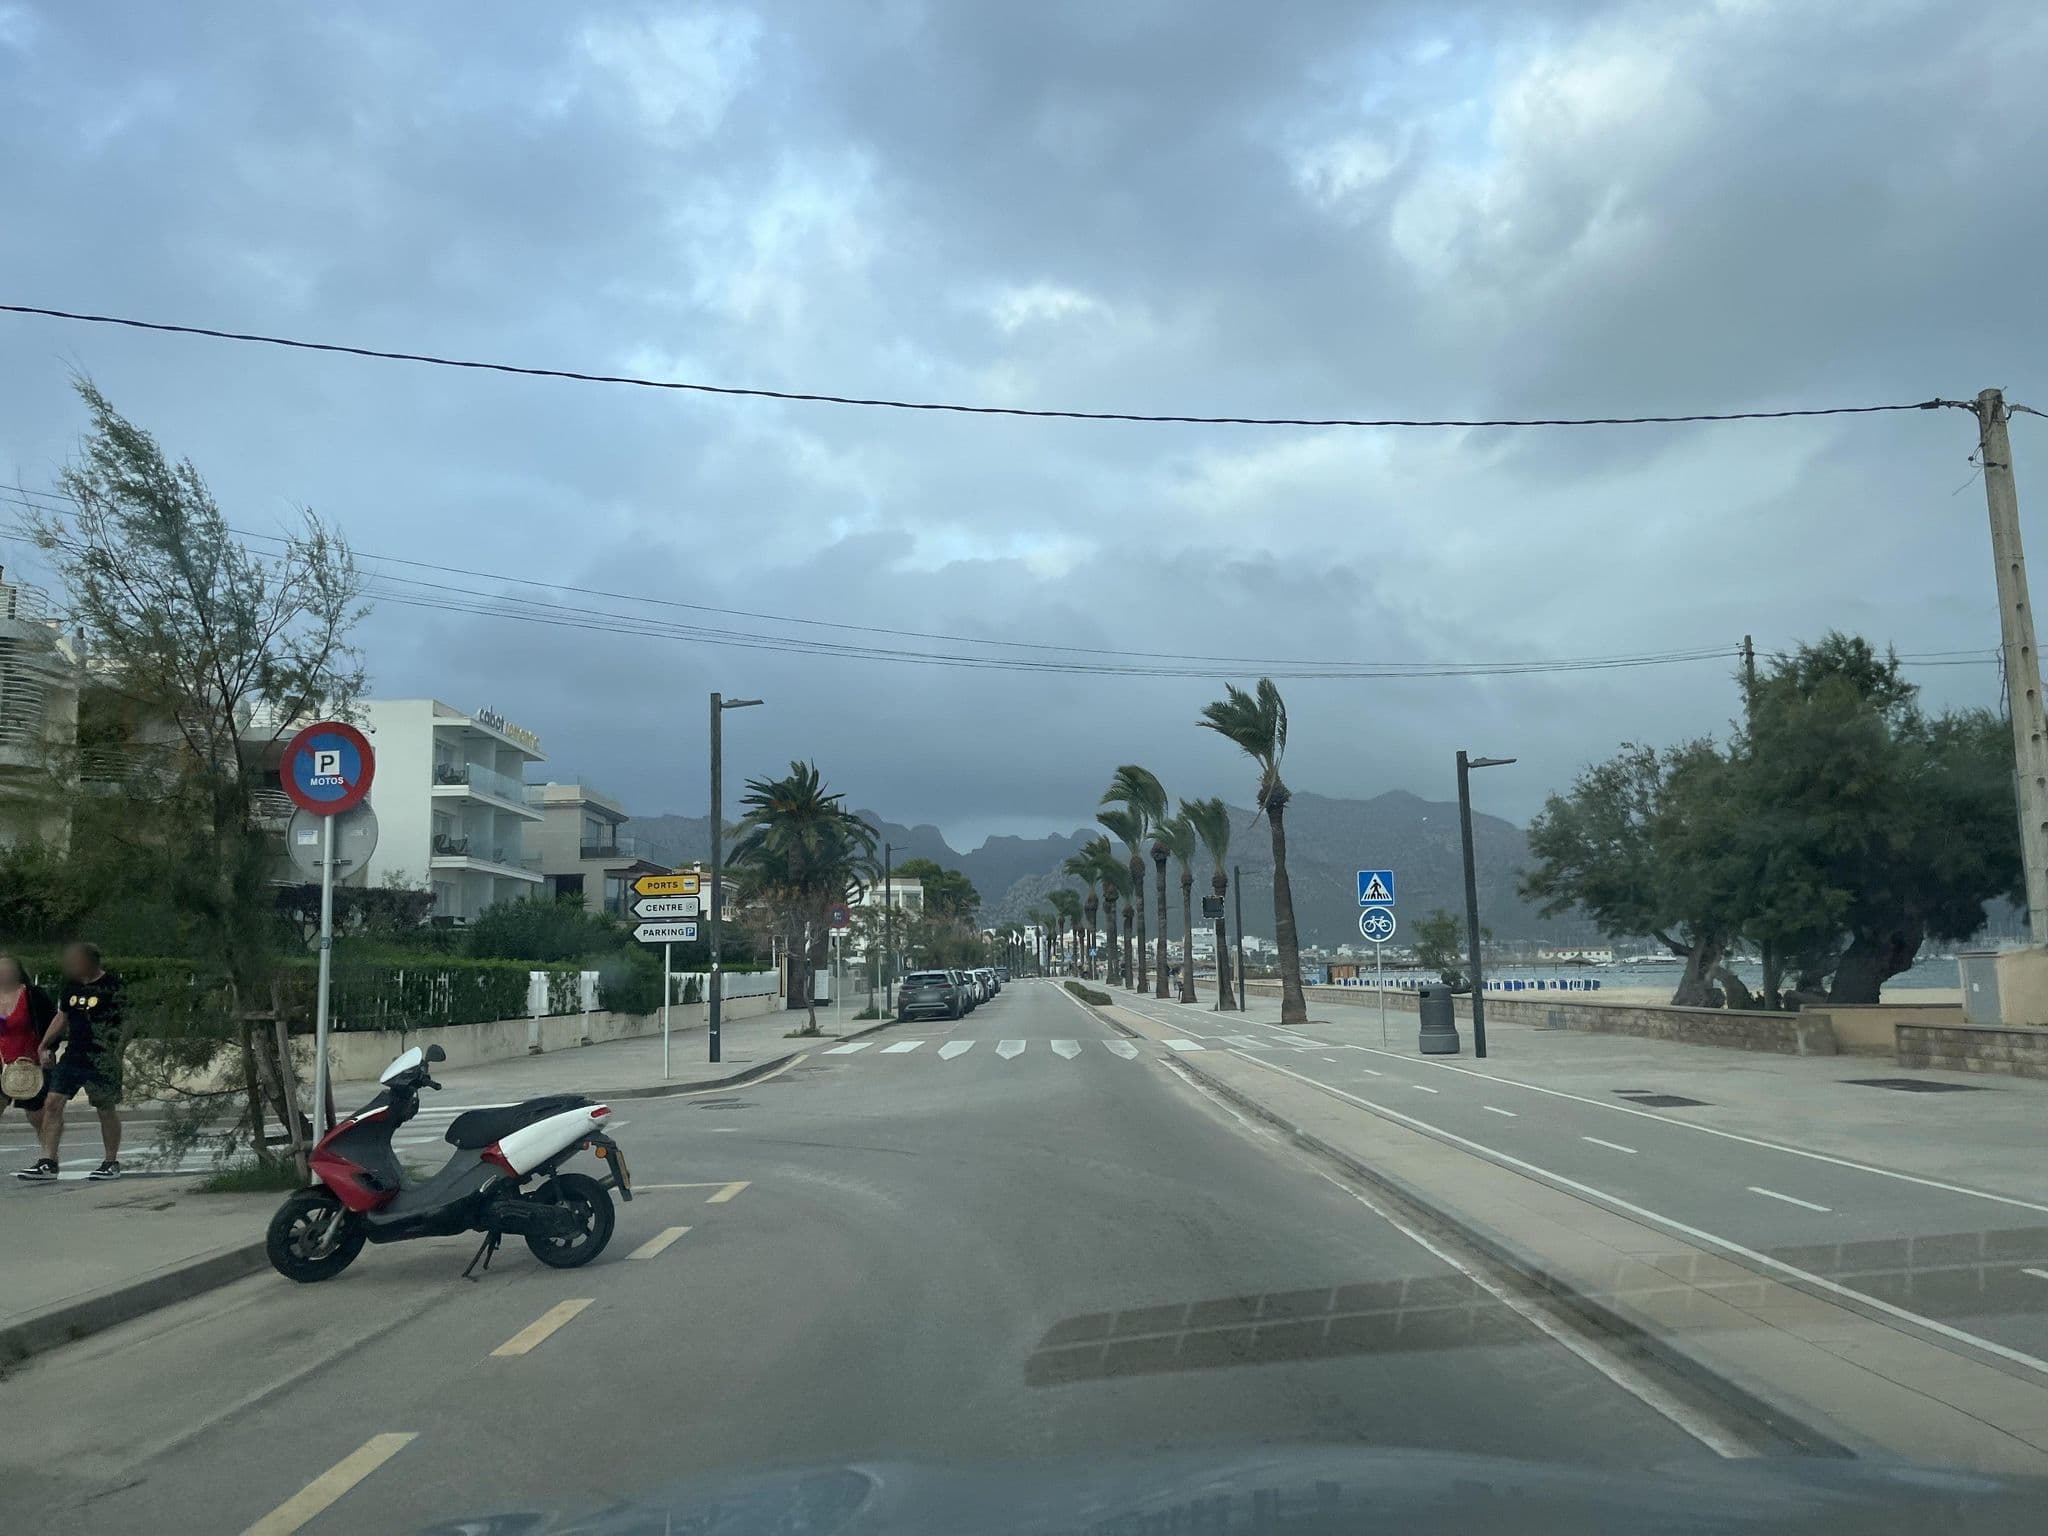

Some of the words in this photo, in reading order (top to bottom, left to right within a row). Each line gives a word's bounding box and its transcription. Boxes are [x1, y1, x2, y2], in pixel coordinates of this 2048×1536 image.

[479, 705, 505, 733] cabot
[320, 755, 335, 773] P
[310, 777, 344, 786] MOTOS
[647, 881, 679, 890] PORTS
[645, 903, 683, 912] CENTRE
[643, 928, 685, 937] PARKING
